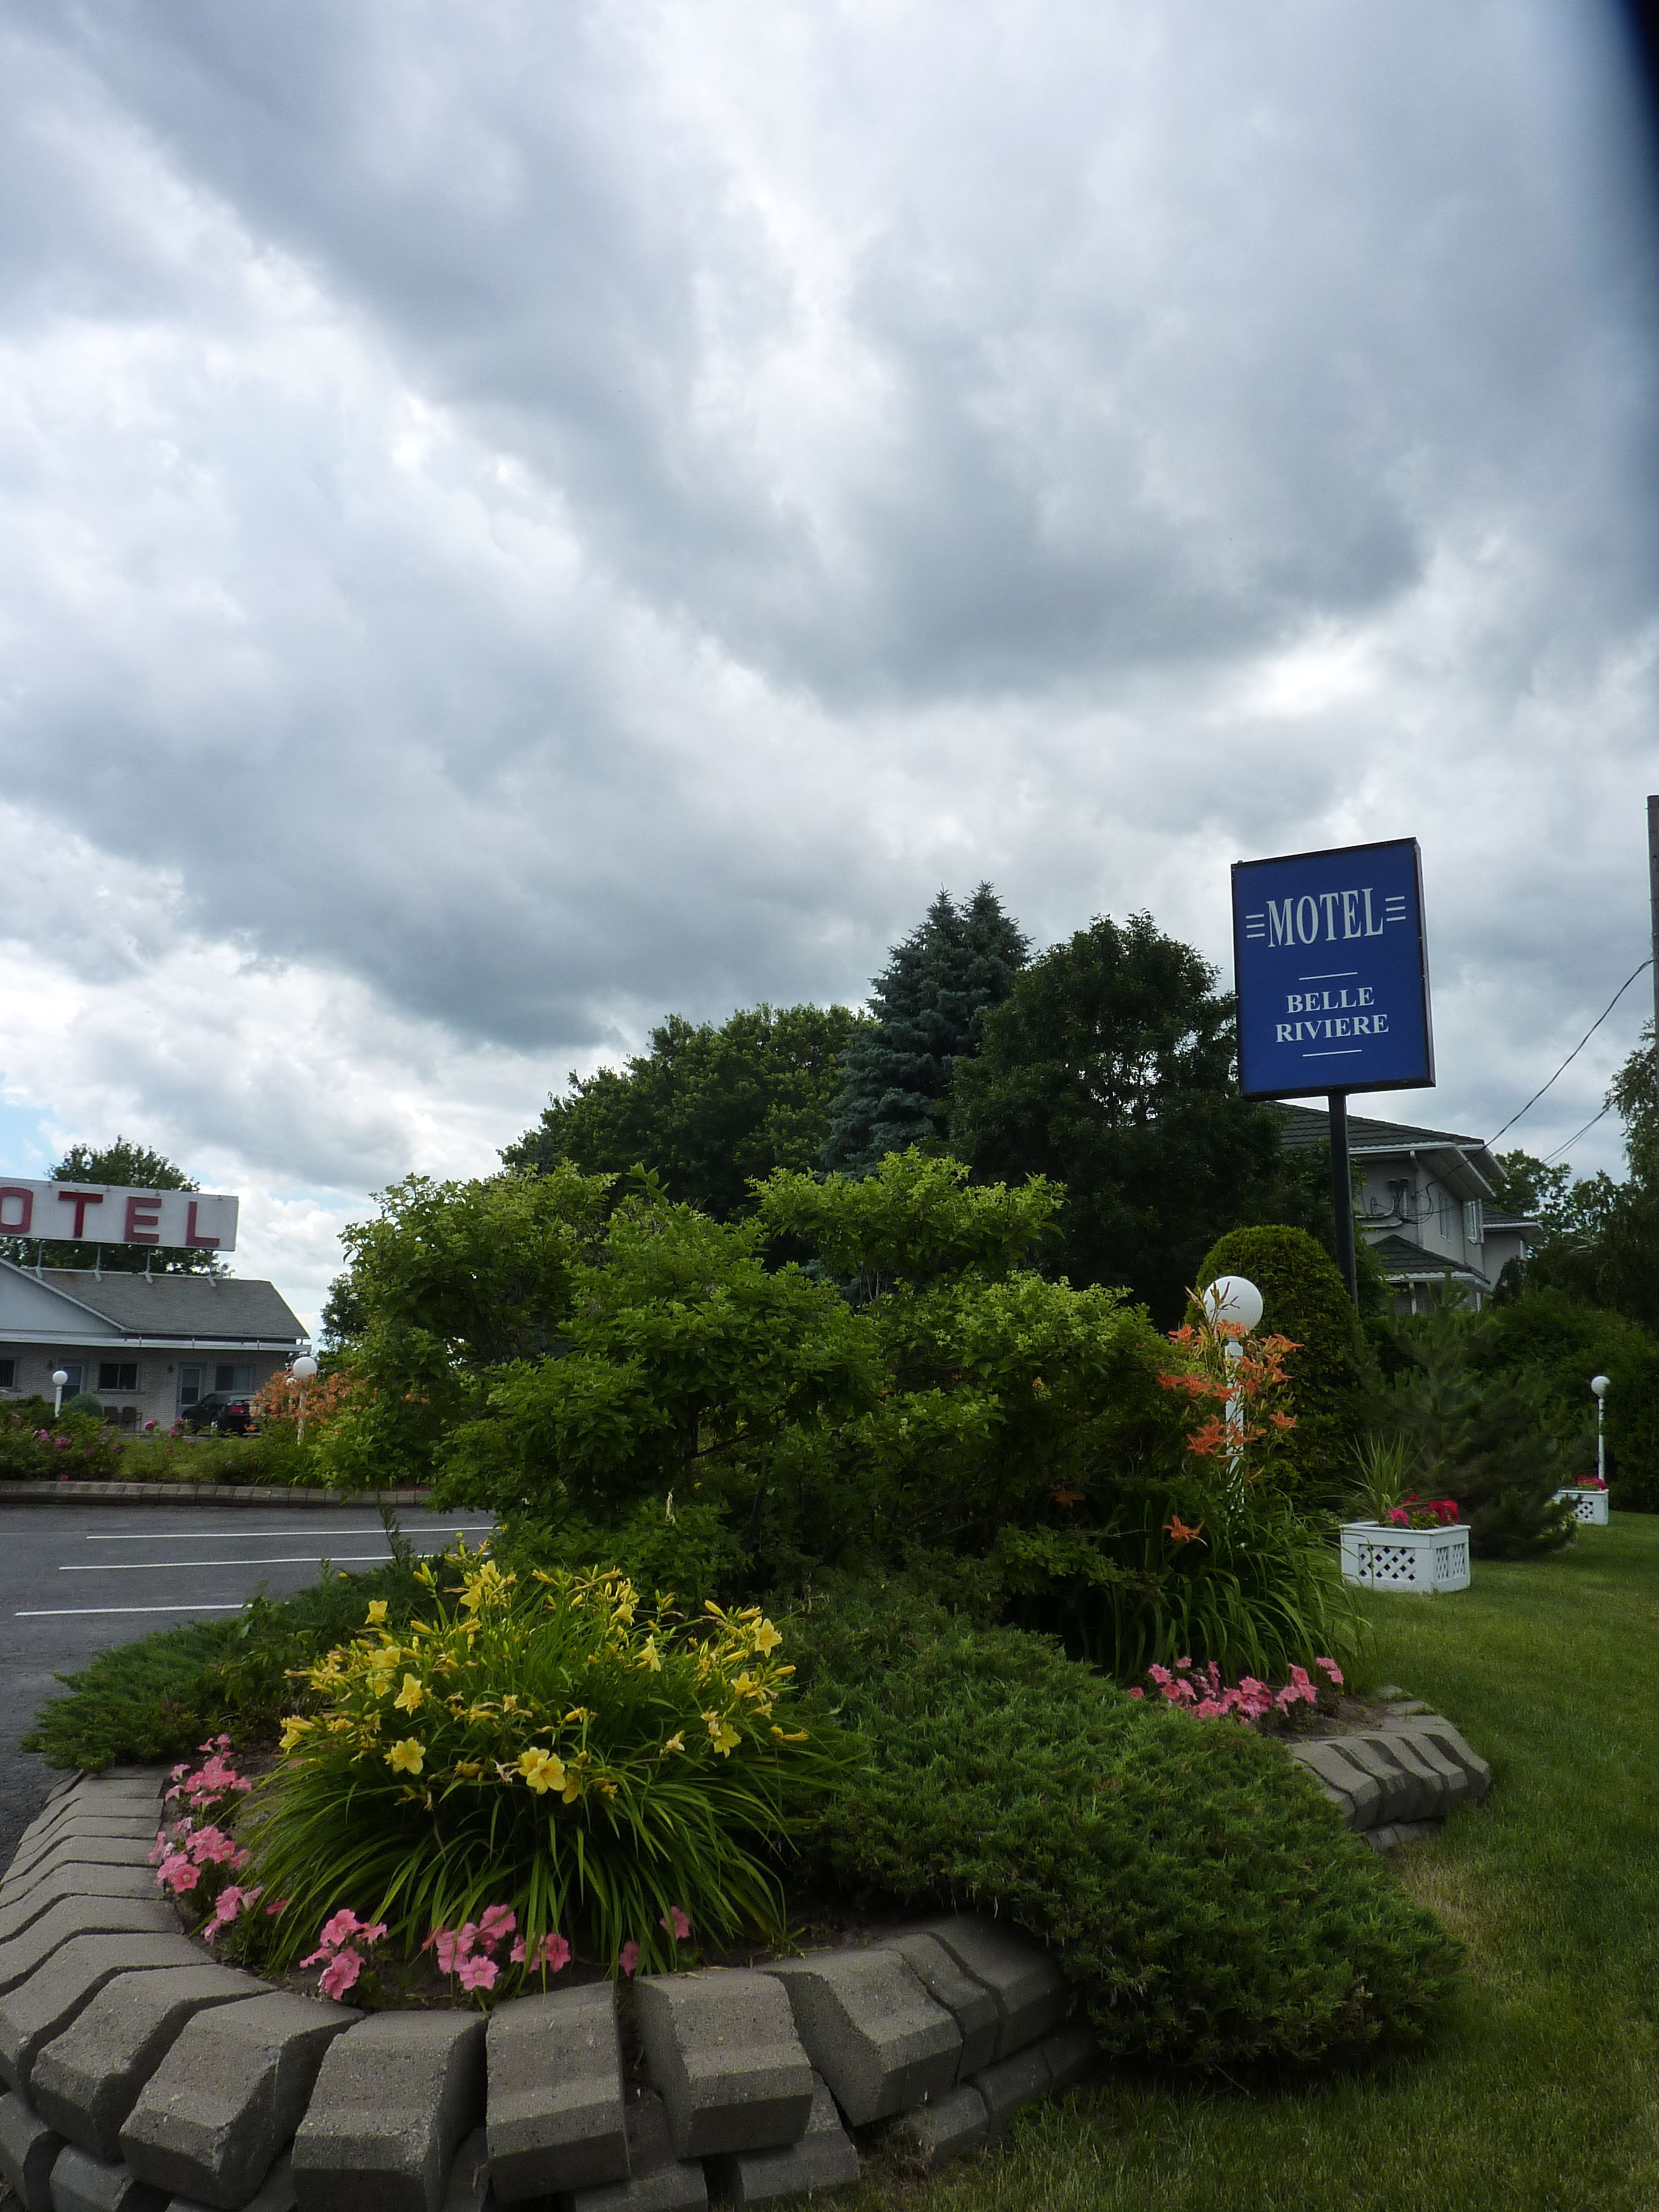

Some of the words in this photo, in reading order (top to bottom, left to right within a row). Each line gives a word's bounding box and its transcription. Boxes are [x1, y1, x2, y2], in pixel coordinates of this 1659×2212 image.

[1266, 888, 1384, 948] MOTEL
[1286, 987, 1375, 1014] BELLE
[1275, 1014, 1389, 1043] RIVIERE
[0, 1187, 220, 1247] OTEL
